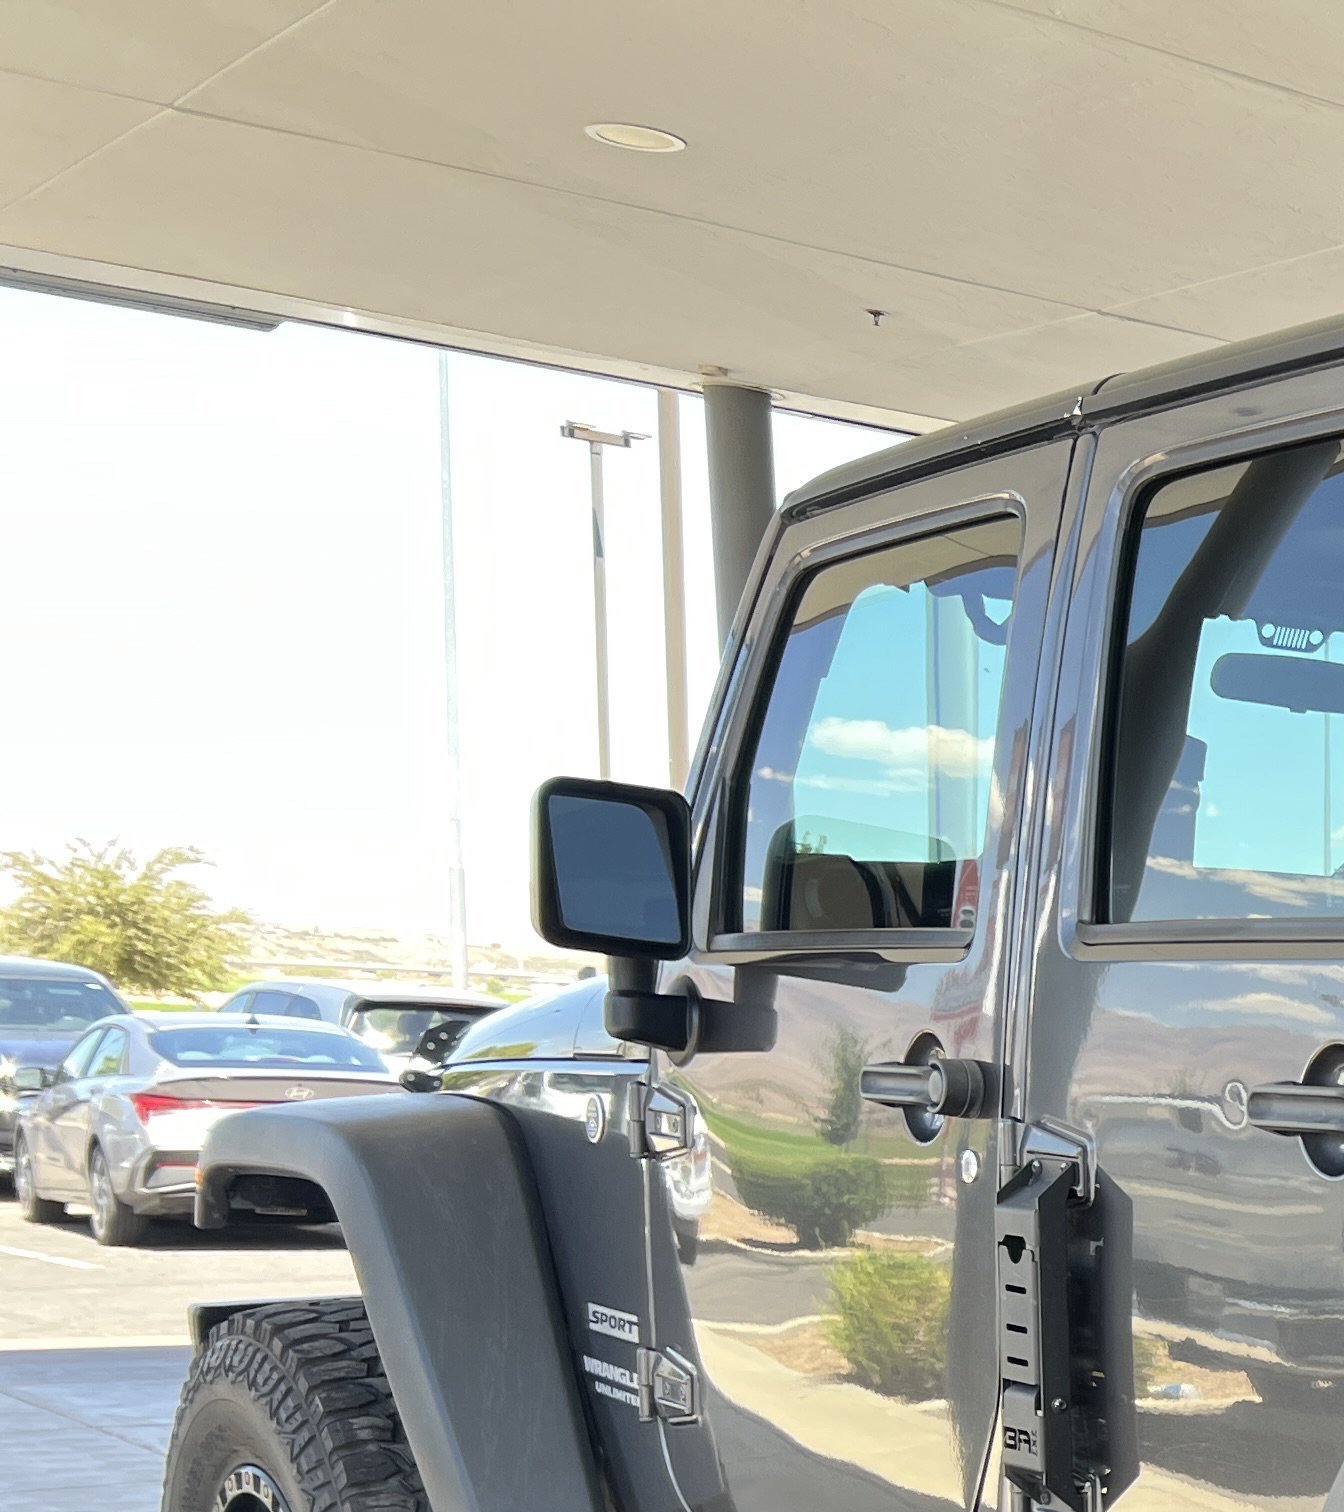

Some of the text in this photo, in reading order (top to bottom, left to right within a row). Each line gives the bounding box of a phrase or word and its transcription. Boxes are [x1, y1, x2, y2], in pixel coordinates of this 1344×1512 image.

[589, 1310, 636, 1335] SPORT
[583, 1354, 640, 1391] WRANGLE
[595, 1380, 640, 1408] UNLIMITE
